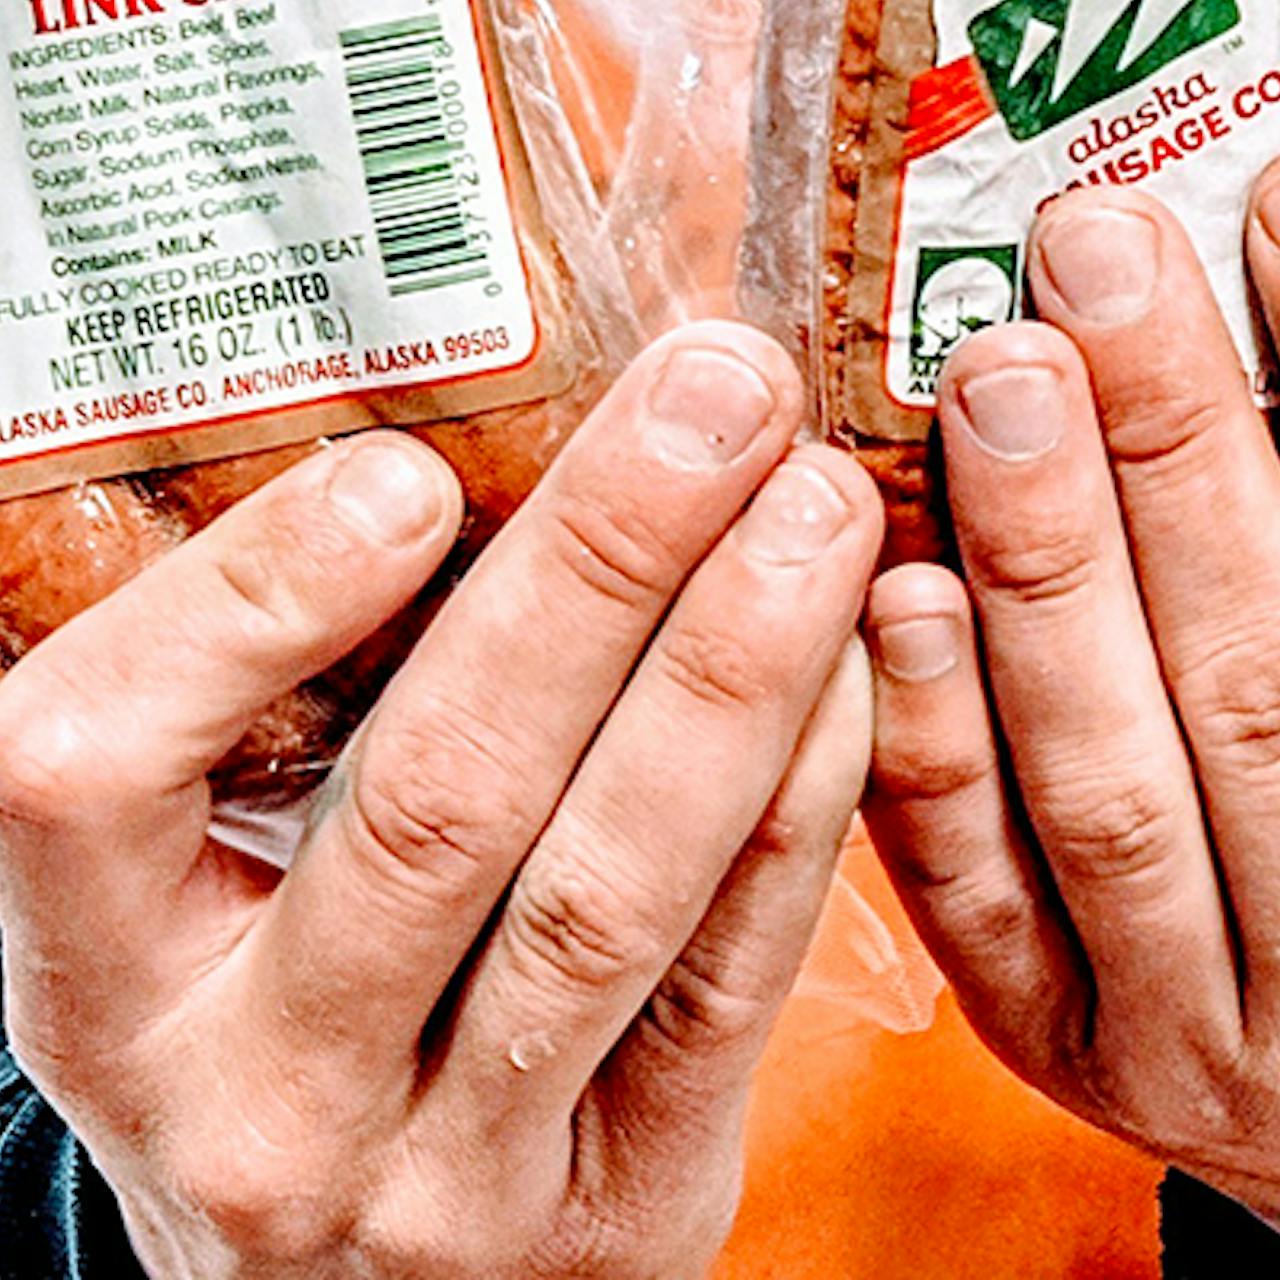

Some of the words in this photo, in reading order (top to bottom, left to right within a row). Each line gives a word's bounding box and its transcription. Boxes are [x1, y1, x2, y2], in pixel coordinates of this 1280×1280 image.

[9, 23, 174, 70] INGREDIENTS:
[76, 62, 150, 88] Water,
[153, 49, 201, 75] Salt,
[19, 102, 83, 130] Nonfat
[88, 93, 137, 119] Milk,
[142, 76, 219, 107] Natural
[431, 41, 468, 137] 00018
[75, 125, 140, 154] Syrup
[1066, 71, 1219, 164] alaska
[31, 162, 96, 191] Sugar,
[98, 146, 183, 178] Sodium
[40, 189, 122, 219] Ascorbic
[186, 161, 263, 192] Sodium
[66, 213, 139, 244] Natural
[143, 203, 194, 231] Pork
[455, 151, 495, 247] 37123
[51, 244, 152, 278] Contains:
[157, 229, 220, 259] MILK
[79, 266, 188, 307] COOKED
[194, 247, 286, 285] READY
[289, 242, 319, 268] TO
[323, 234, 368, 264] EAT
[65, 307, 126, 348] KEEP
[133, 271, 333, 338] REFRIGERATED
[482, 281, 504, 299] 0
[48, 347, 111, 393] NET
[118, 338, 166, 380] WT.
[172, 332, 208, 370] 16
[218, 321, 268, 363] OZ.
[275, 313, 305, 358] (1
[309, 304, 355, 347] lb.)
[75, 388, 173, 428] SAUSAGE
[175, 382, 217, 411] CO.
[222, 351, 362, 400] ANCHORAGE,
[364, 342, 439, 376] ALASKA
[444, 325, 511, 363] 99503
